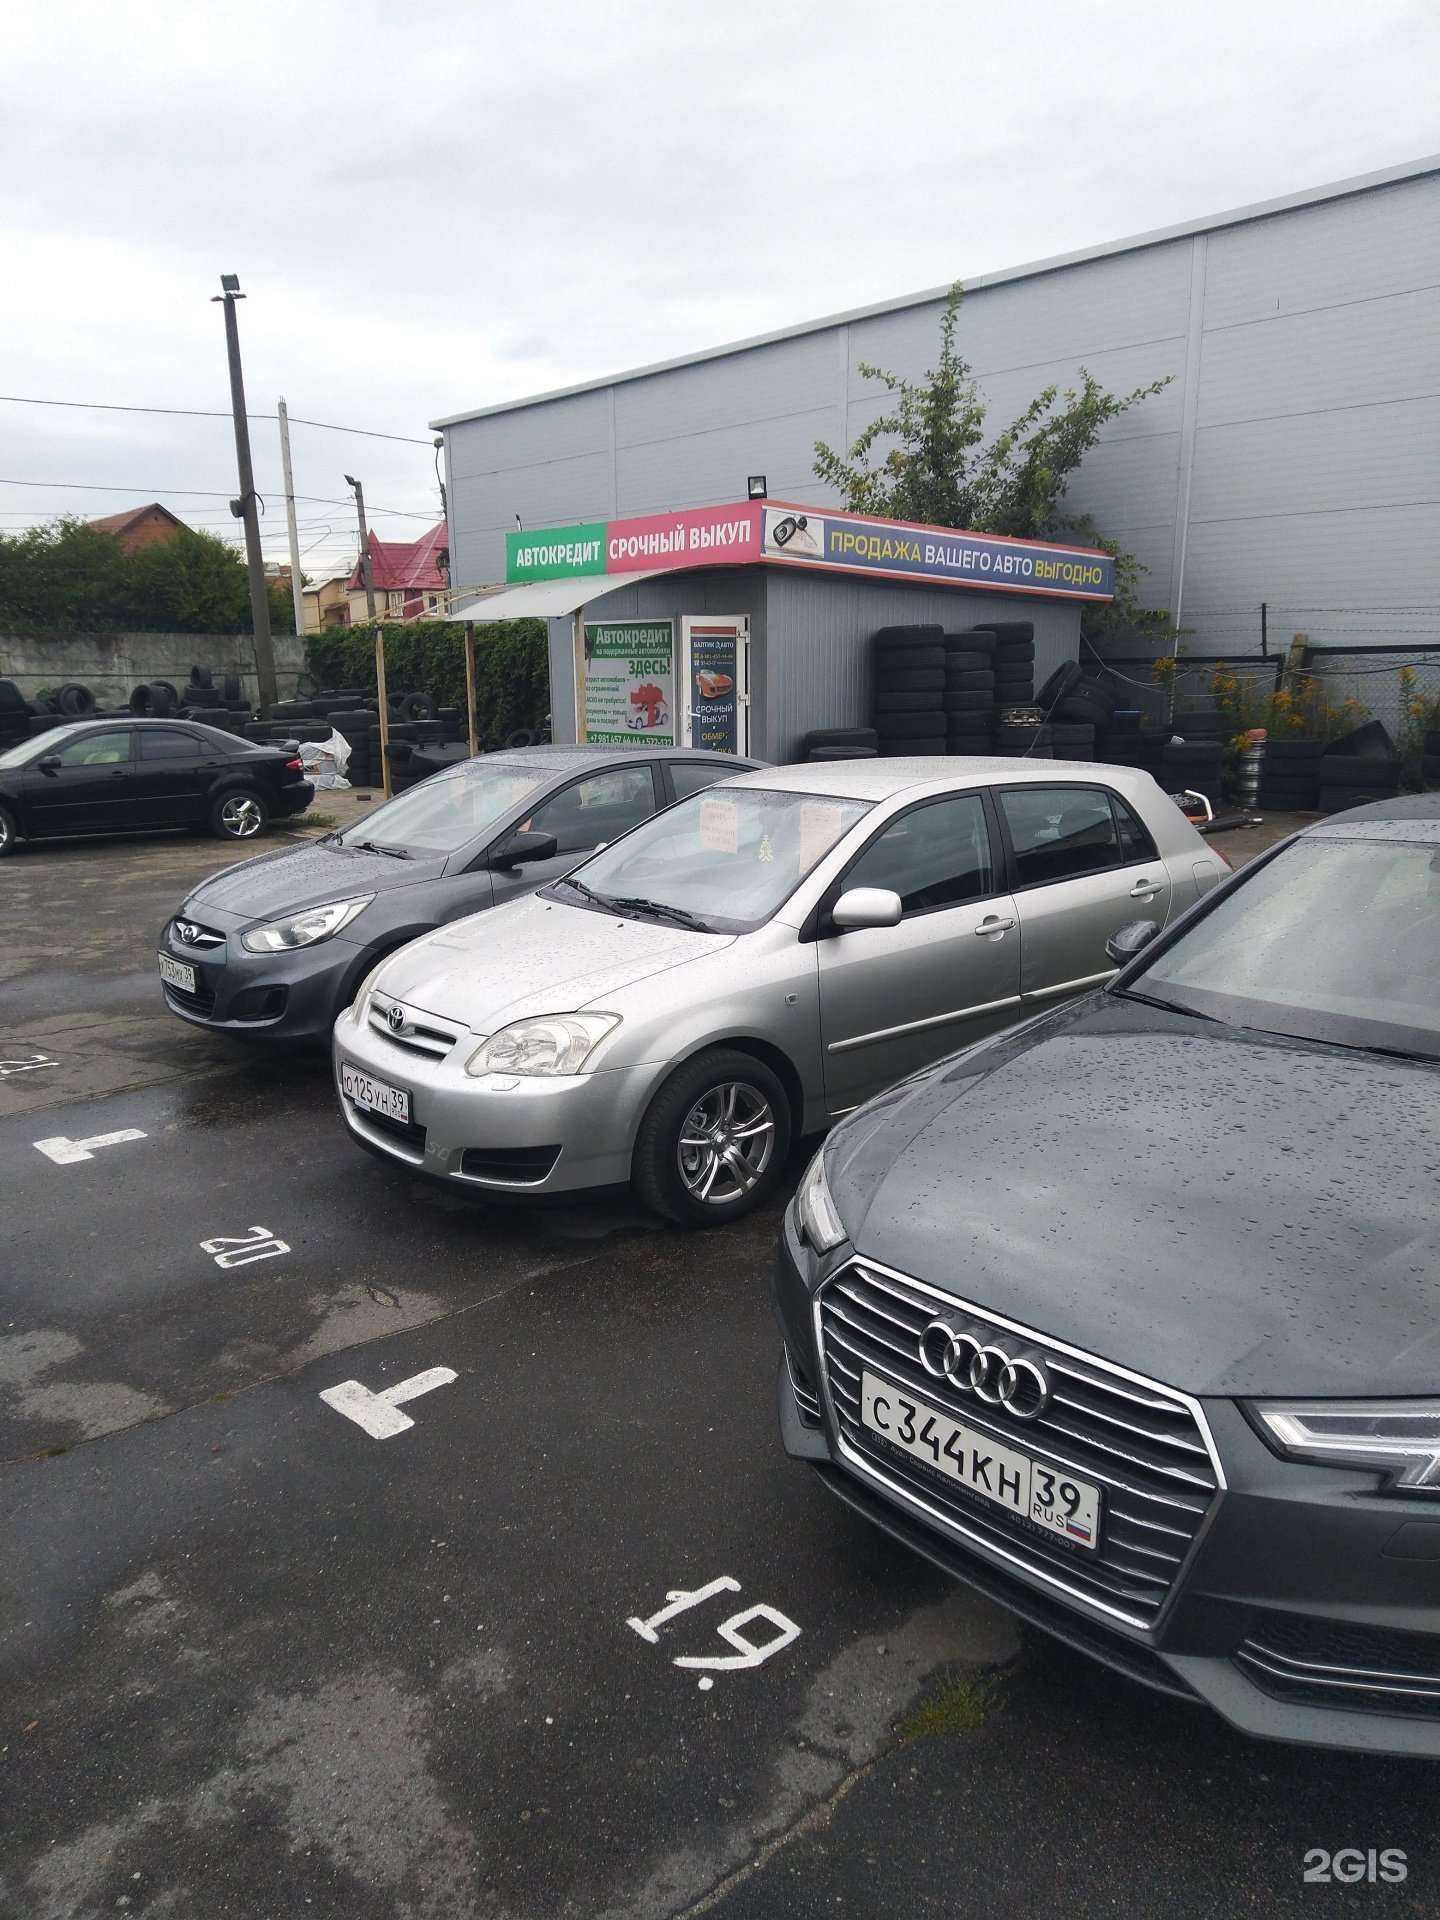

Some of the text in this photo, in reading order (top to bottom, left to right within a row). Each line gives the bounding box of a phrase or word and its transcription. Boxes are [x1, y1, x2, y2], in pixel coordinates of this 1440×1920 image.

[609, 520, 751, 560] СРОЧНЫЙ ВЫКУП
[516, 541, 601, 567] АВТОКРЕДИТ
[831, 532, 1102, 585] ПРОДАЖА ВАШЕГО АВТО ВЫГОДНО
[596, 627, 670, 648] Автокредит
[628, 655, 671, 679] здесь!
[696, 704, 733, 713] СРОЧНЫЙ
[702, 715, 727, 724] ВЫКУП
[391, 1091, 404, 1110] 39
[200, 1226, 291, 1268] 20
[1036, 1469, 1081, 1519] 39
[1033, 1503, 1065, 1528] RUS
